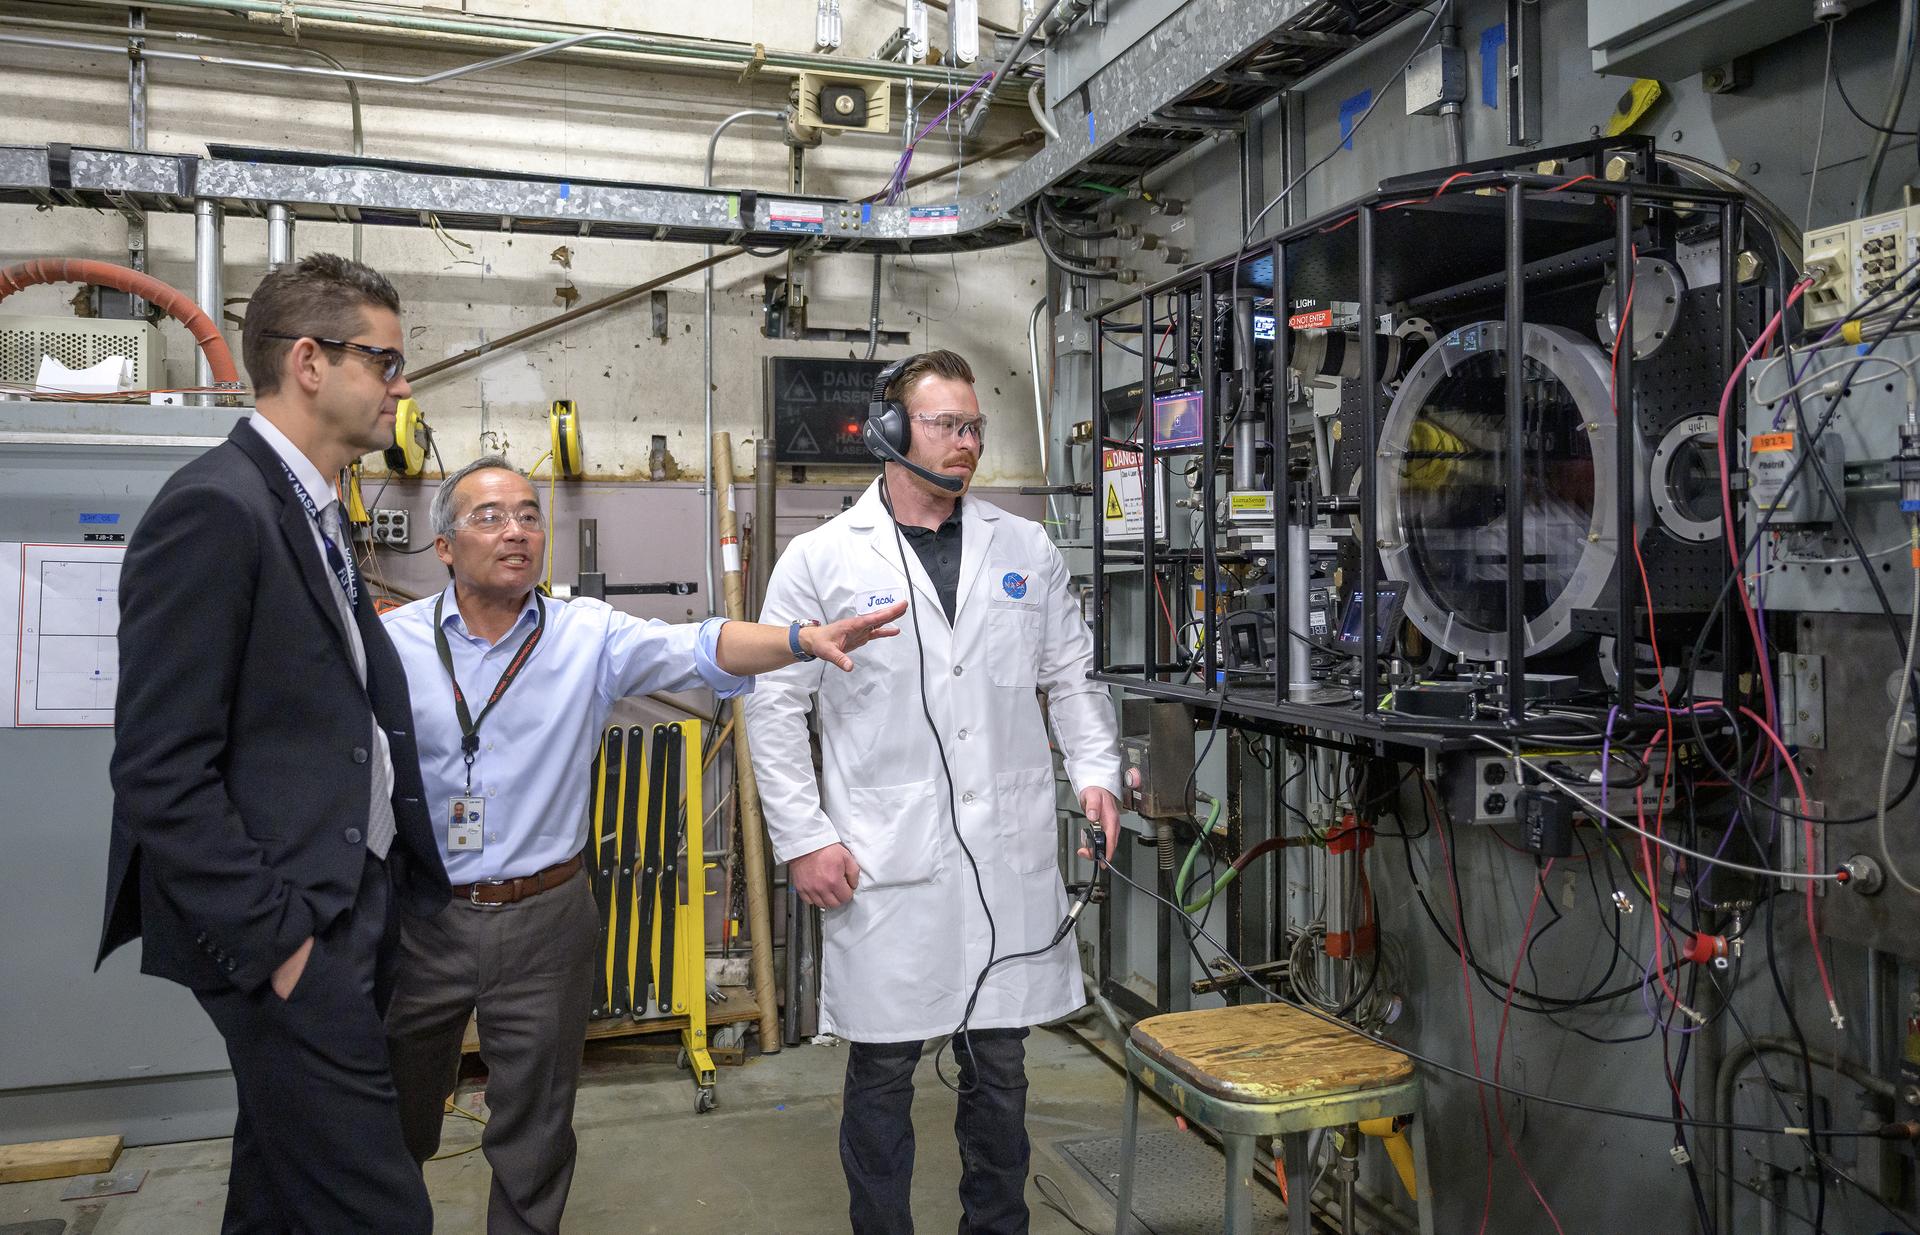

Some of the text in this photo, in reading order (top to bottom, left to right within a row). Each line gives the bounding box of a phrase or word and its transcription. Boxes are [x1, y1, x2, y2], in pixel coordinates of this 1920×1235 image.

[1296, 315, 1308, 325] NOT
[1309, 312, 1326, 323] ENTER
[293, 484, 317, 517] NASA
[867, 594, 896, 607] Jacob
